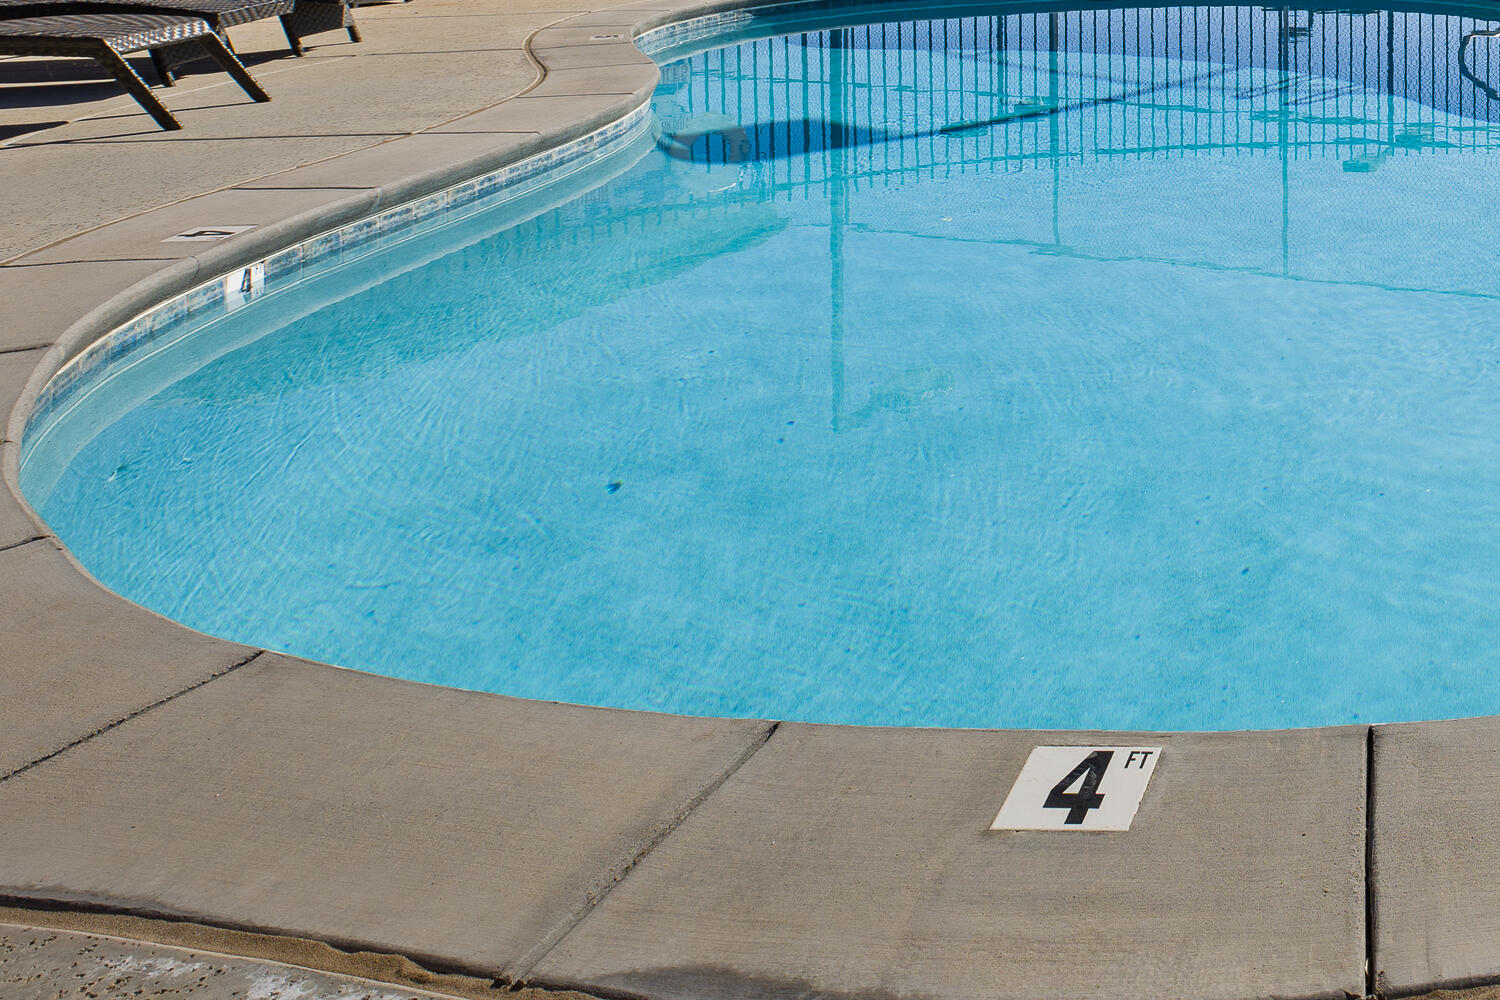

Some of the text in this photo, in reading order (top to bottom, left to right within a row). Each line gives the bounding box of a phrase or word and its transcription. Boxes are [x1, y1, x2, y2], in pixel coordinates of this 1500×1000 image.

[240, 268, 252, 299] 4
[1042, 750, 1153, 825] 4 FT
